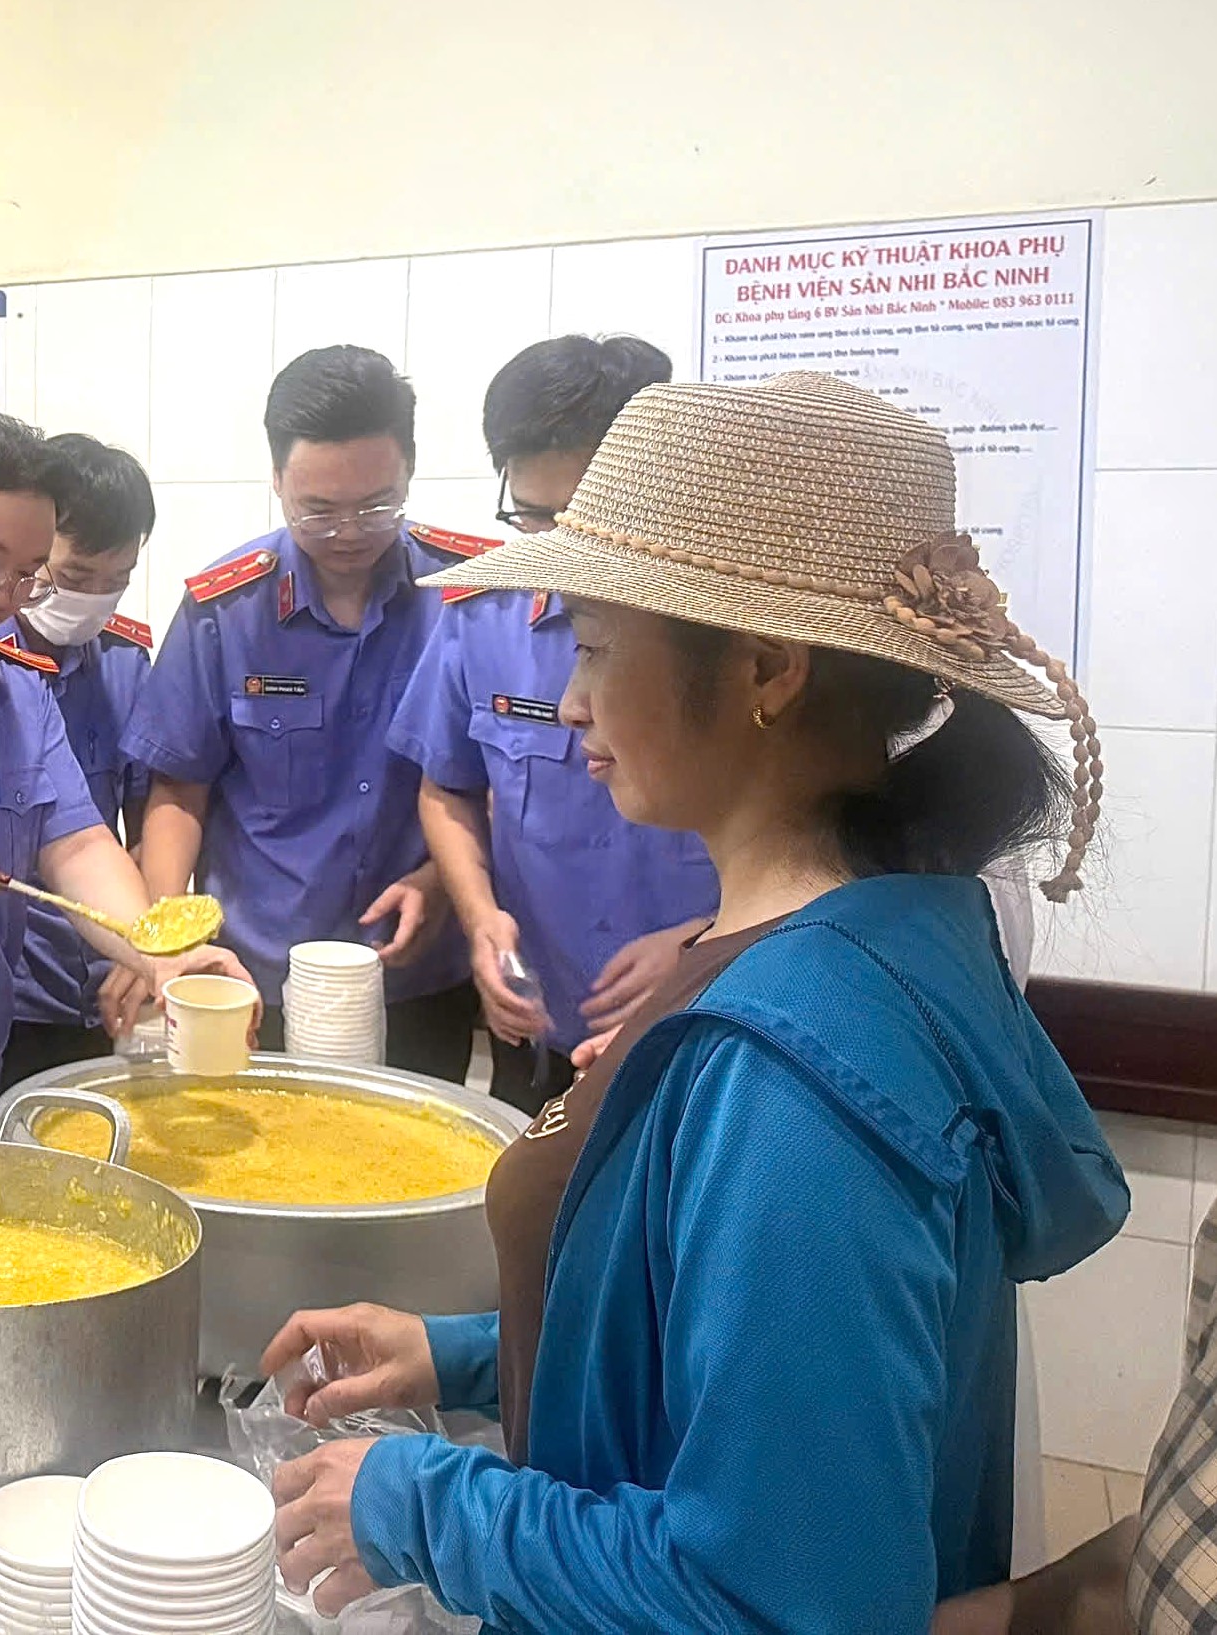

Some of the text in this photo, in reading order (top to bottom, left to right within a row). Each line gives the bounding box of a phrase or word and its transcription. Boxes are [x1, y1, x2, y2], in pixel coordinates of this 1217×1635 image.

[725, 235, 1065, 275] DANH MỤC KỸ THUẬT KHOA PHỤ
[737, 263, 1050, 305] BỆNH VIỆN SẢN NHI BẮC NINH
[735, 311, 761, 323] Khoa
[764, 310, 784, 324] phụ
[814, 307, 822, 318] 6
[824, 306, 839, 318] BV
[841, 305, 862, 316] Sản
[865, 303, 883, 315] Nhi
[887, 301, 907, 315] Bắc
[910, 299, 936, 312] Ninh
[948, 297, 990, 311] Mobile:
[1018, 294, 1042, 307] 963
[1045, 293, 1074, 306] 0111
